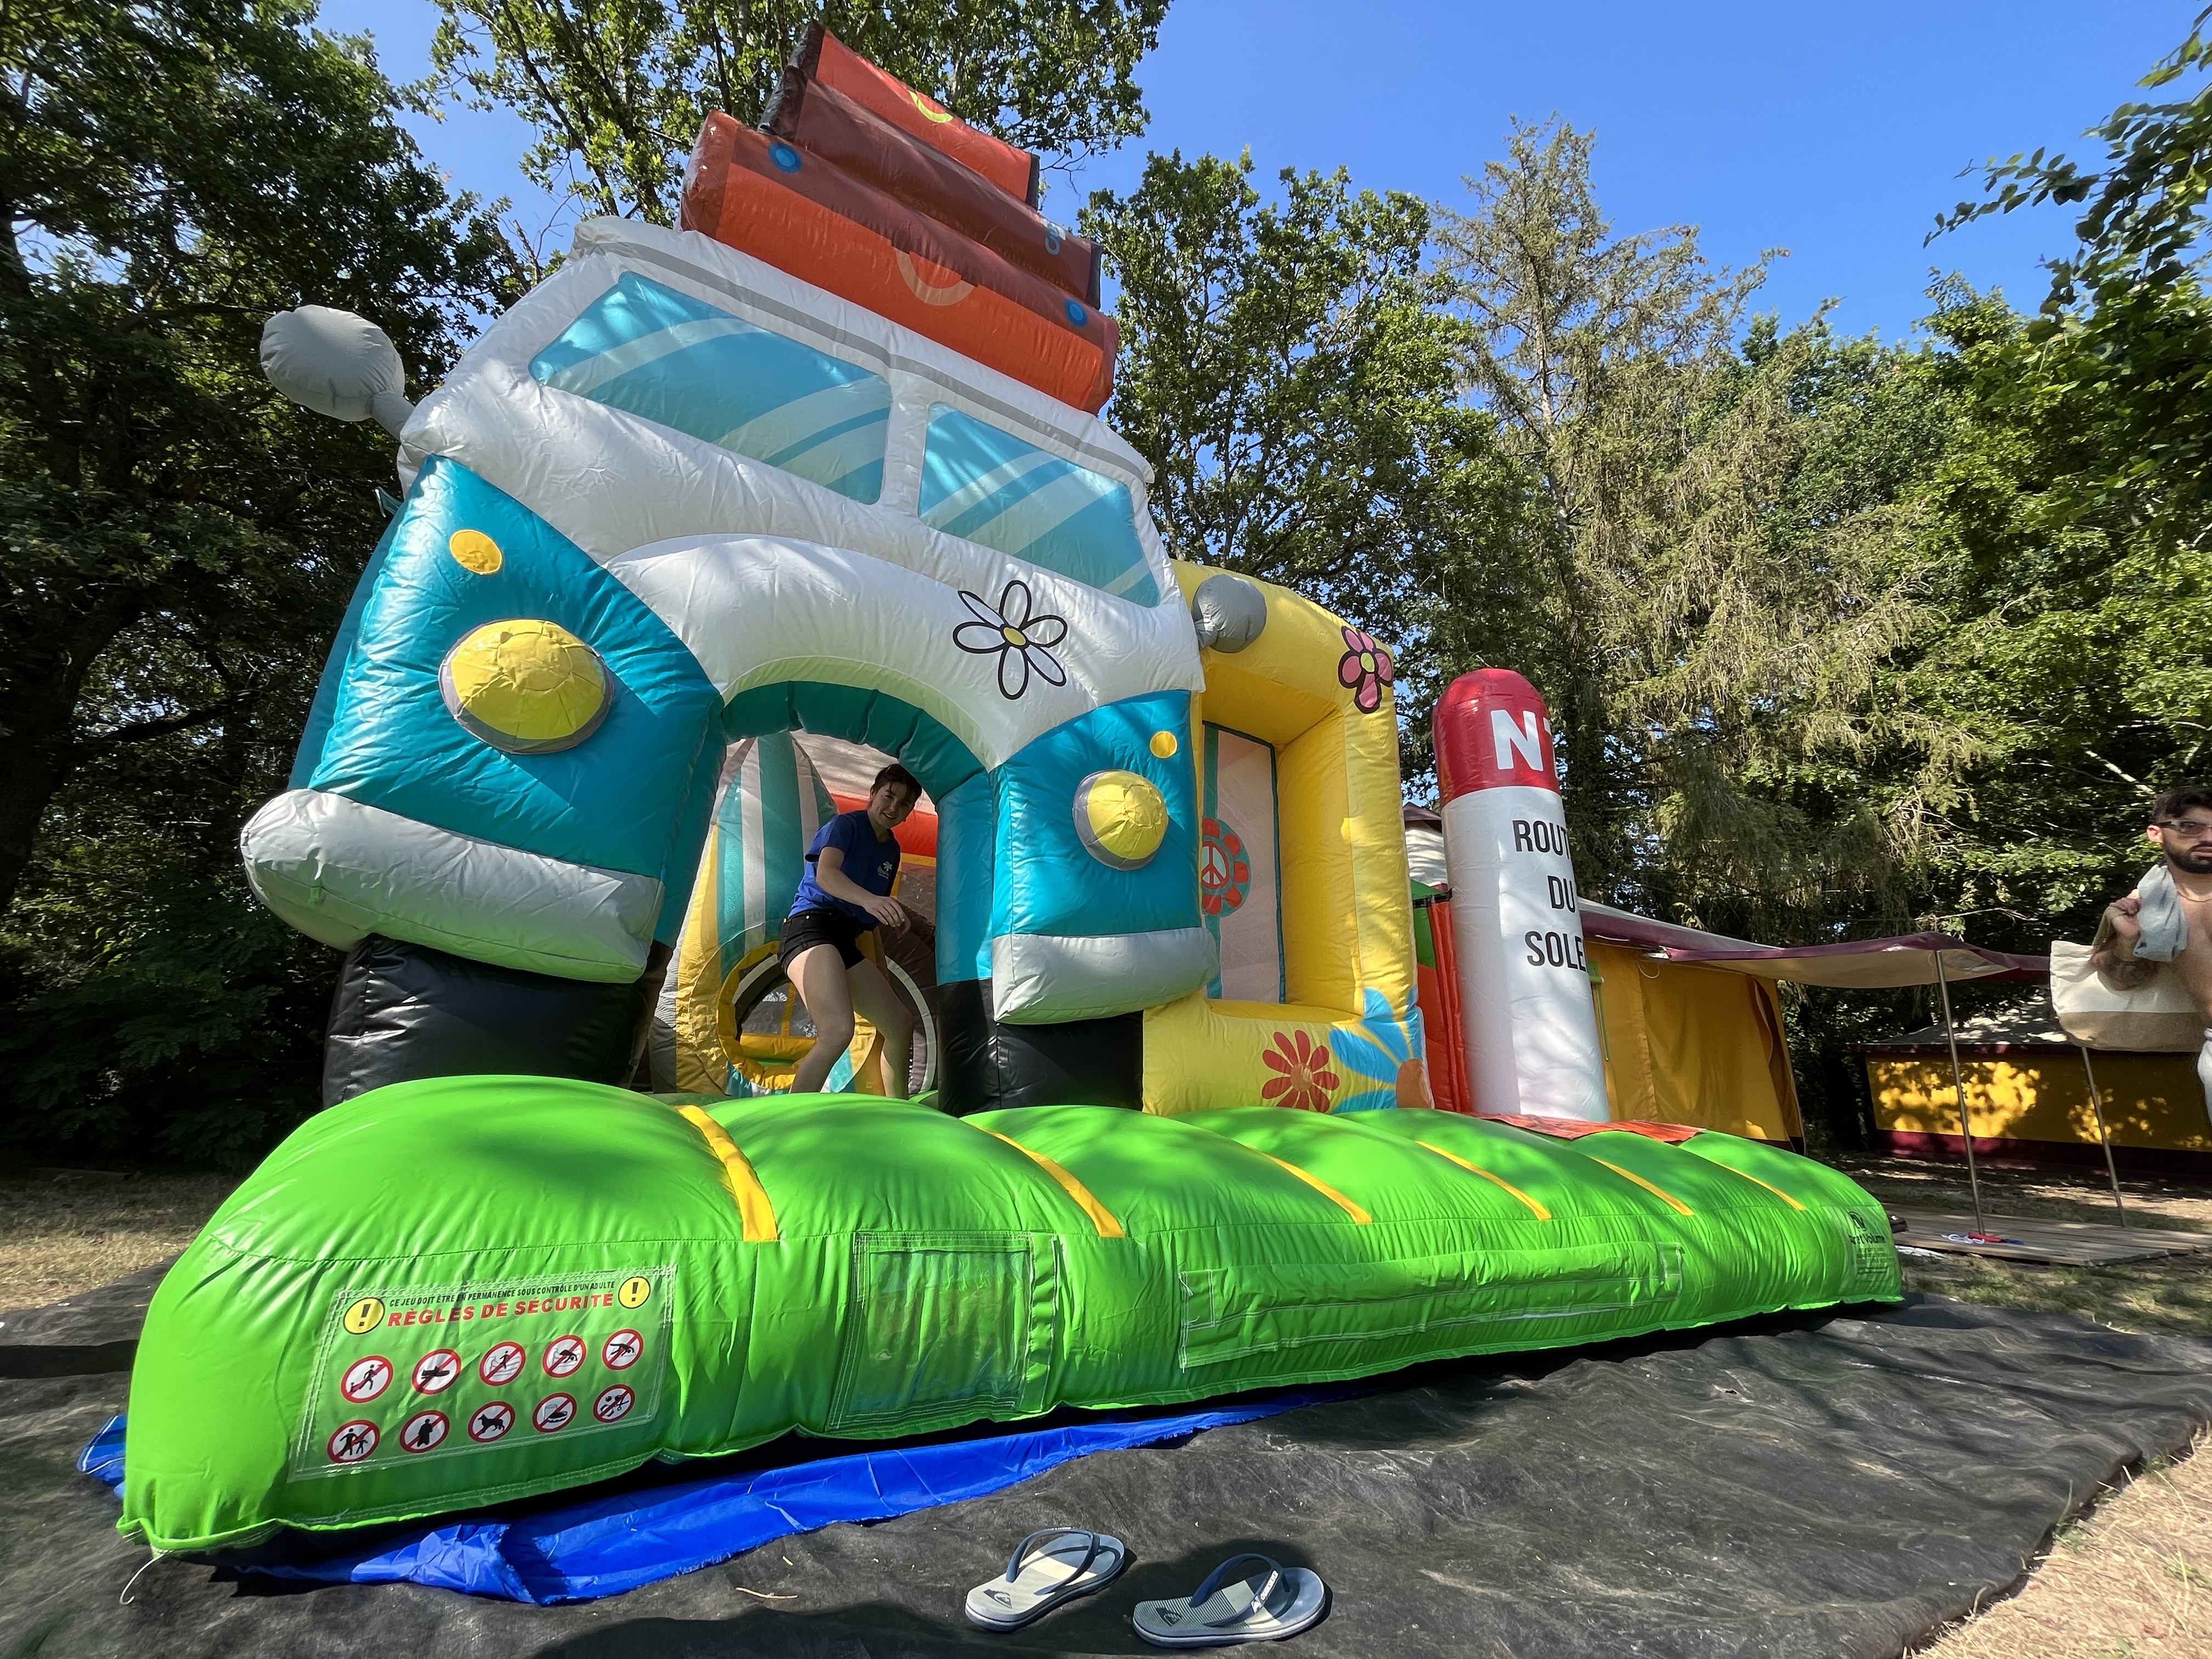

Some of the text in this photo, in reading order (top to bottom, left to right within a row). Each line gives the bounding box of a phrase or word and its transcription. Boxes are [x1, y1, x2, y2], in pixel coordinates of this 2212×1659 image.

[1491, 709, 1559, 779] N
[1512, 820, 1570, 860] ROUT
[1547, 875, 1575, 913] DU
[1525, 930, 1587, 972] SOLE
[387, 1290, 614, 1327] RÈGLES DE SÉCURITÉ
[390, 1299, 400, 1307] CE
[400, 1297, 416, 1306] JEU
[417, 1296, 436, 1305] DOIT
[436, 1294, 455, 1303] ÊTRE
[467, 1289, 515, 1301] PERMANENCE
[537, 1284, 572, 1294] CONTRÔLE
[590, 1281, 615, 1290] ADULTE
